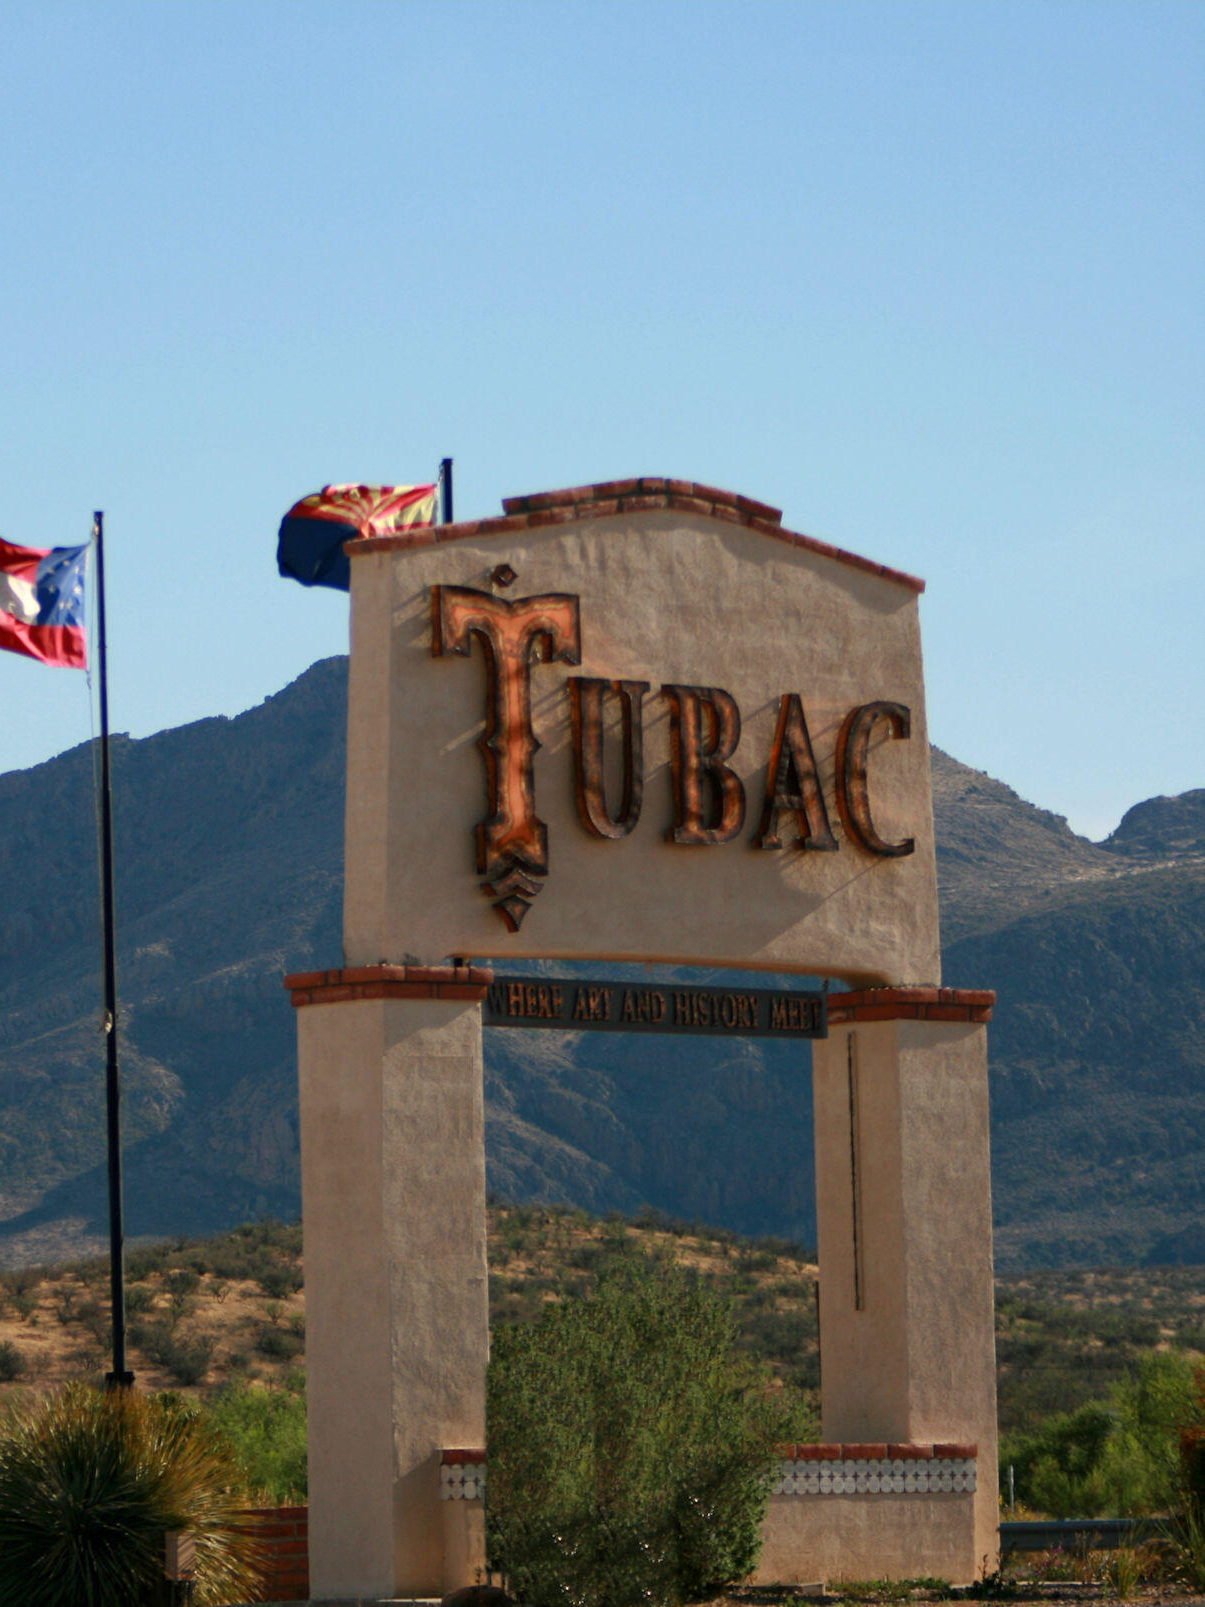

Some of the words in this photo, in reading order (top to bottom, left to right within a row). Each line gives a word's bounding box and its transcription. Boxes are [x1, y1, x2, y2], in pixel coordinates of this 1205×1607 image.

[431, 585, 915, 875] TUBAC
[572, 987, 613, 1021] ART
[620, 990, 667, 1023] AND
[673, 991, 760, 1028] HISTORY
[769, 996, 823, 1031] MEET
